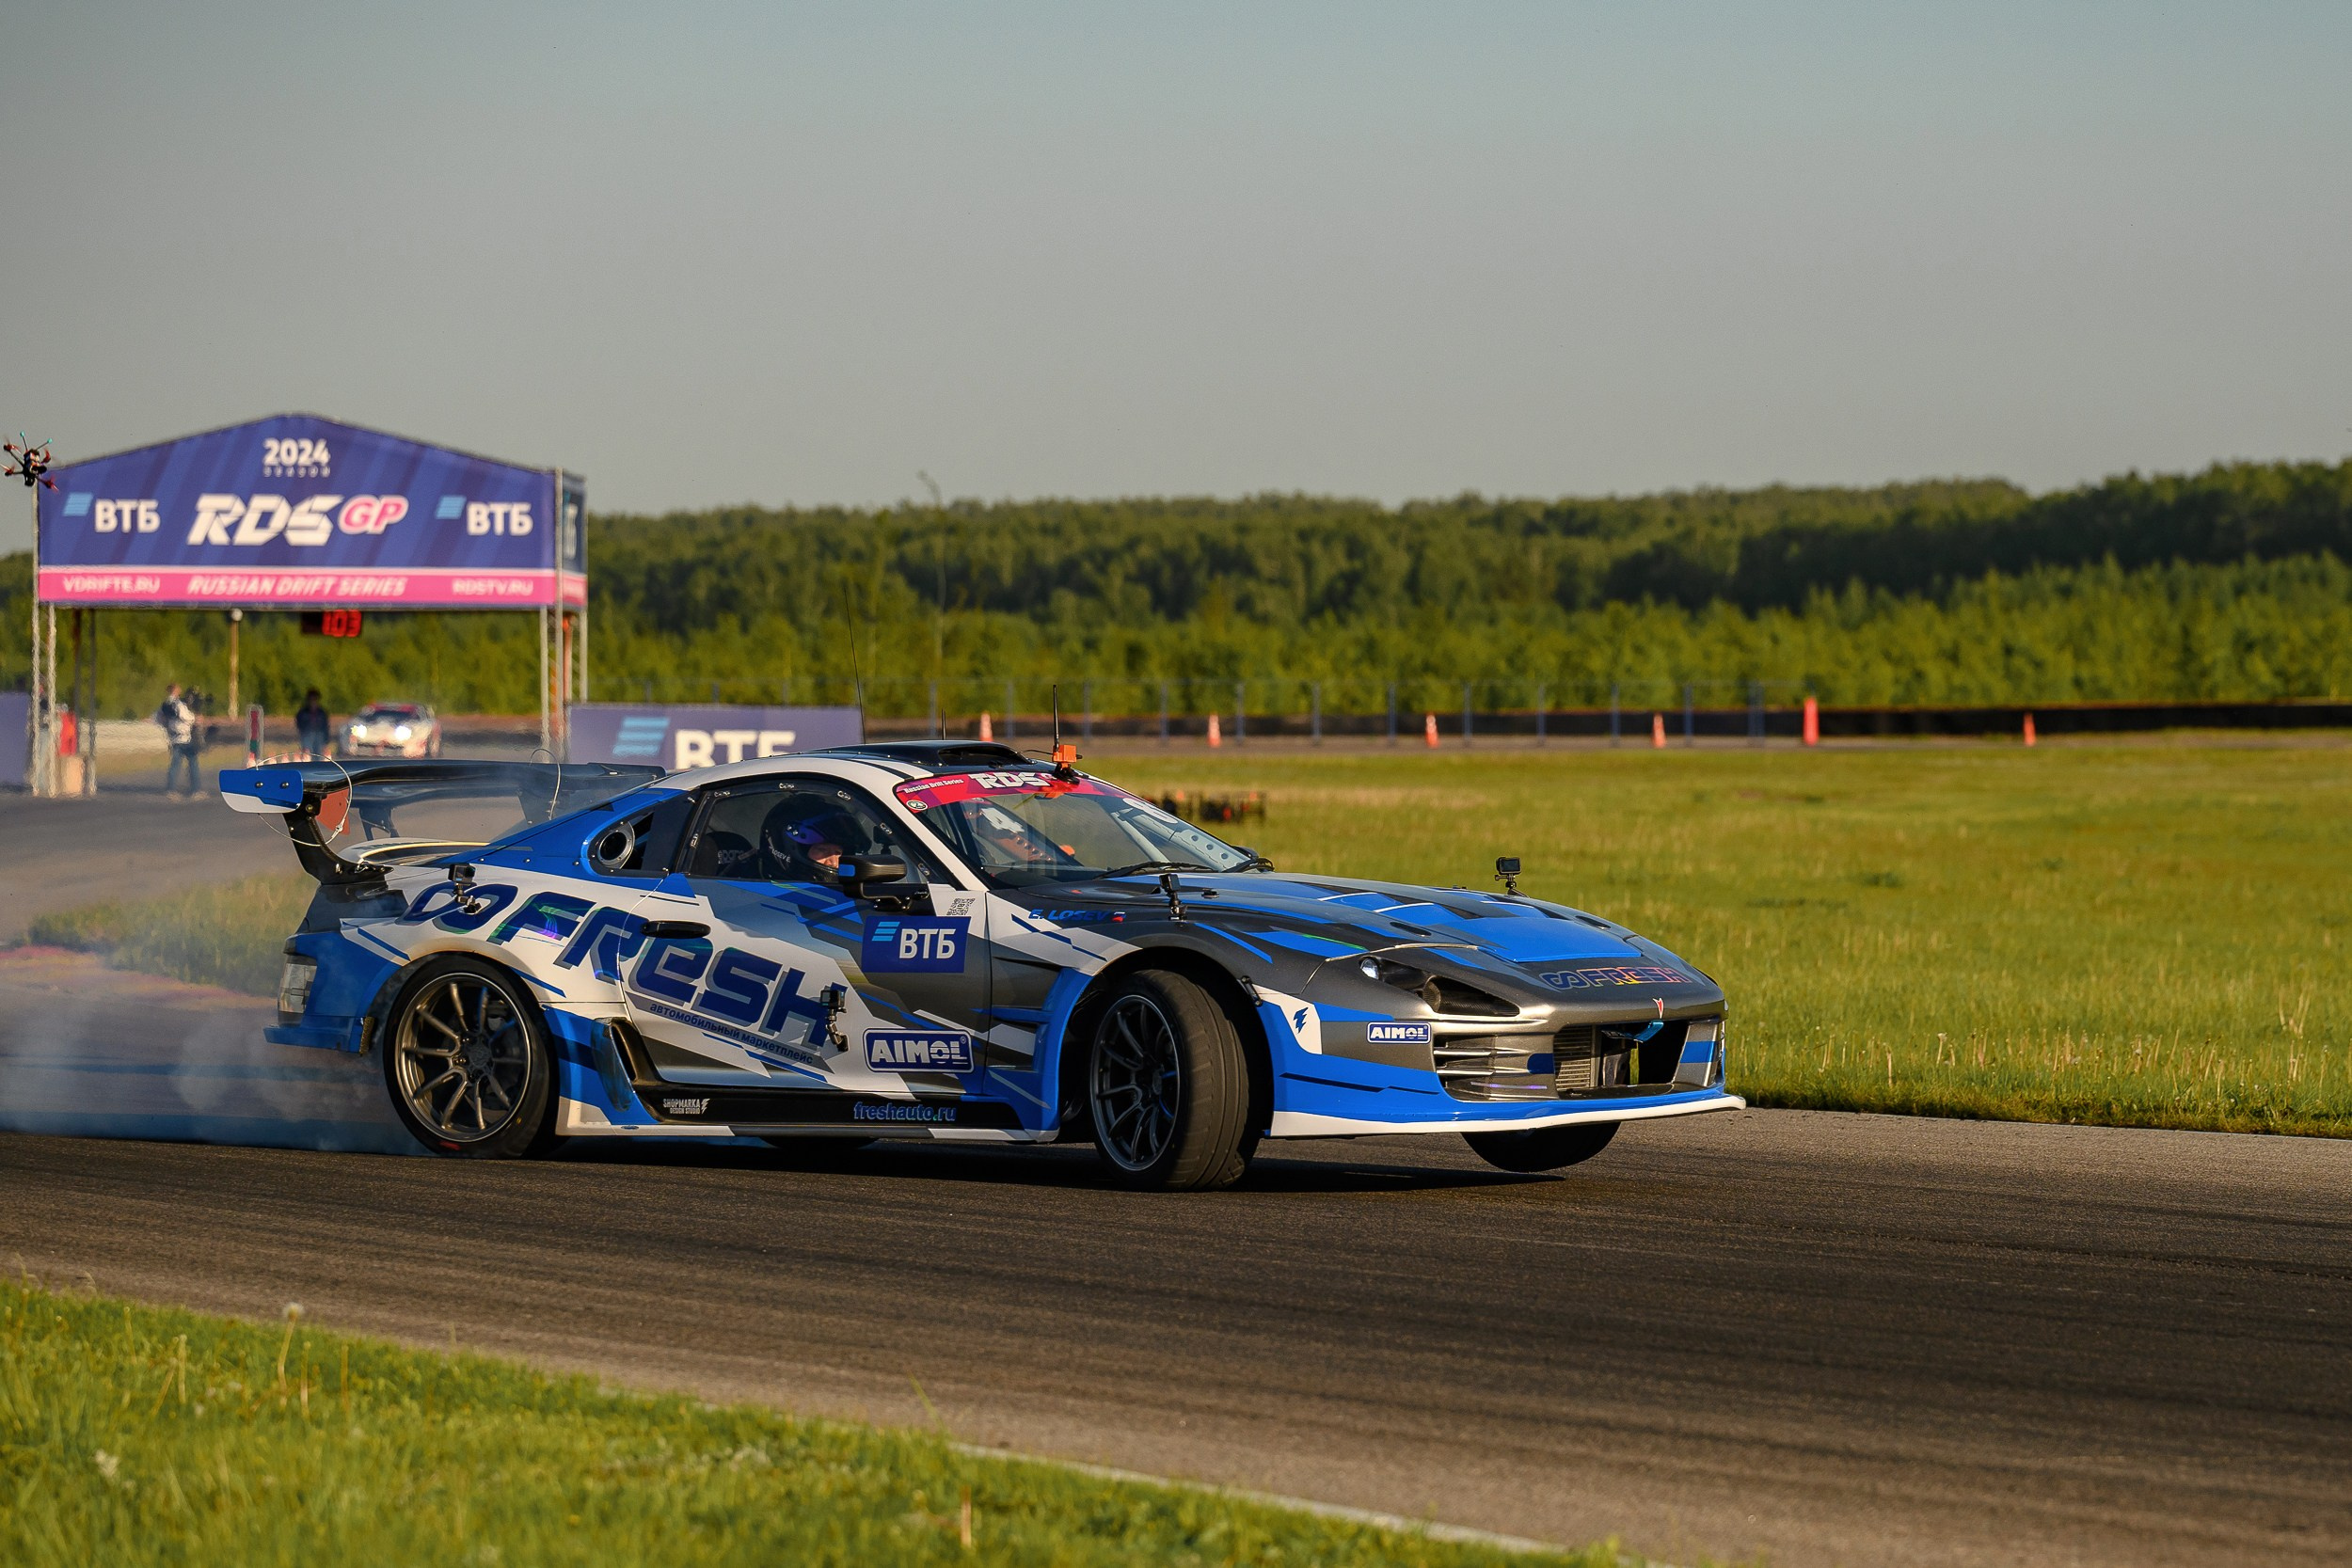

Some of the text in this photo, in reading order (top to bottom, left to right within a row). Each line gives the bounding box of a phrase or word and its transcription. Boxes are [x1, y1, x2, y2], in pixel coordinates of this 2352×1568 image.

[262, 438, 330, 466] 2024
[95, 499, 160, 533] ВТБ
[186, 493, 408, 546] RDS GP
[467, 501, 533, 536] ВТБ
[187, 576, 408, 596] RUSSIAN DRIFT SERIES
[903, 784, 930, 794] Russian
[929, 781, 945, 789] Drift
[968, 771, 1053, 789] RDS
[1047, 910, 1111, 922] LOSEV
[898, 928, 956, 958] ВТБ
[650, 1003, 814, 1065] автомобильный маркетплейс
[1370, 1026, 1427, 1039] AIMOL
[663, 1099, 700, 1108] SHOPMARKA
[853, 1101, 956, 1121] freshauto.ru
